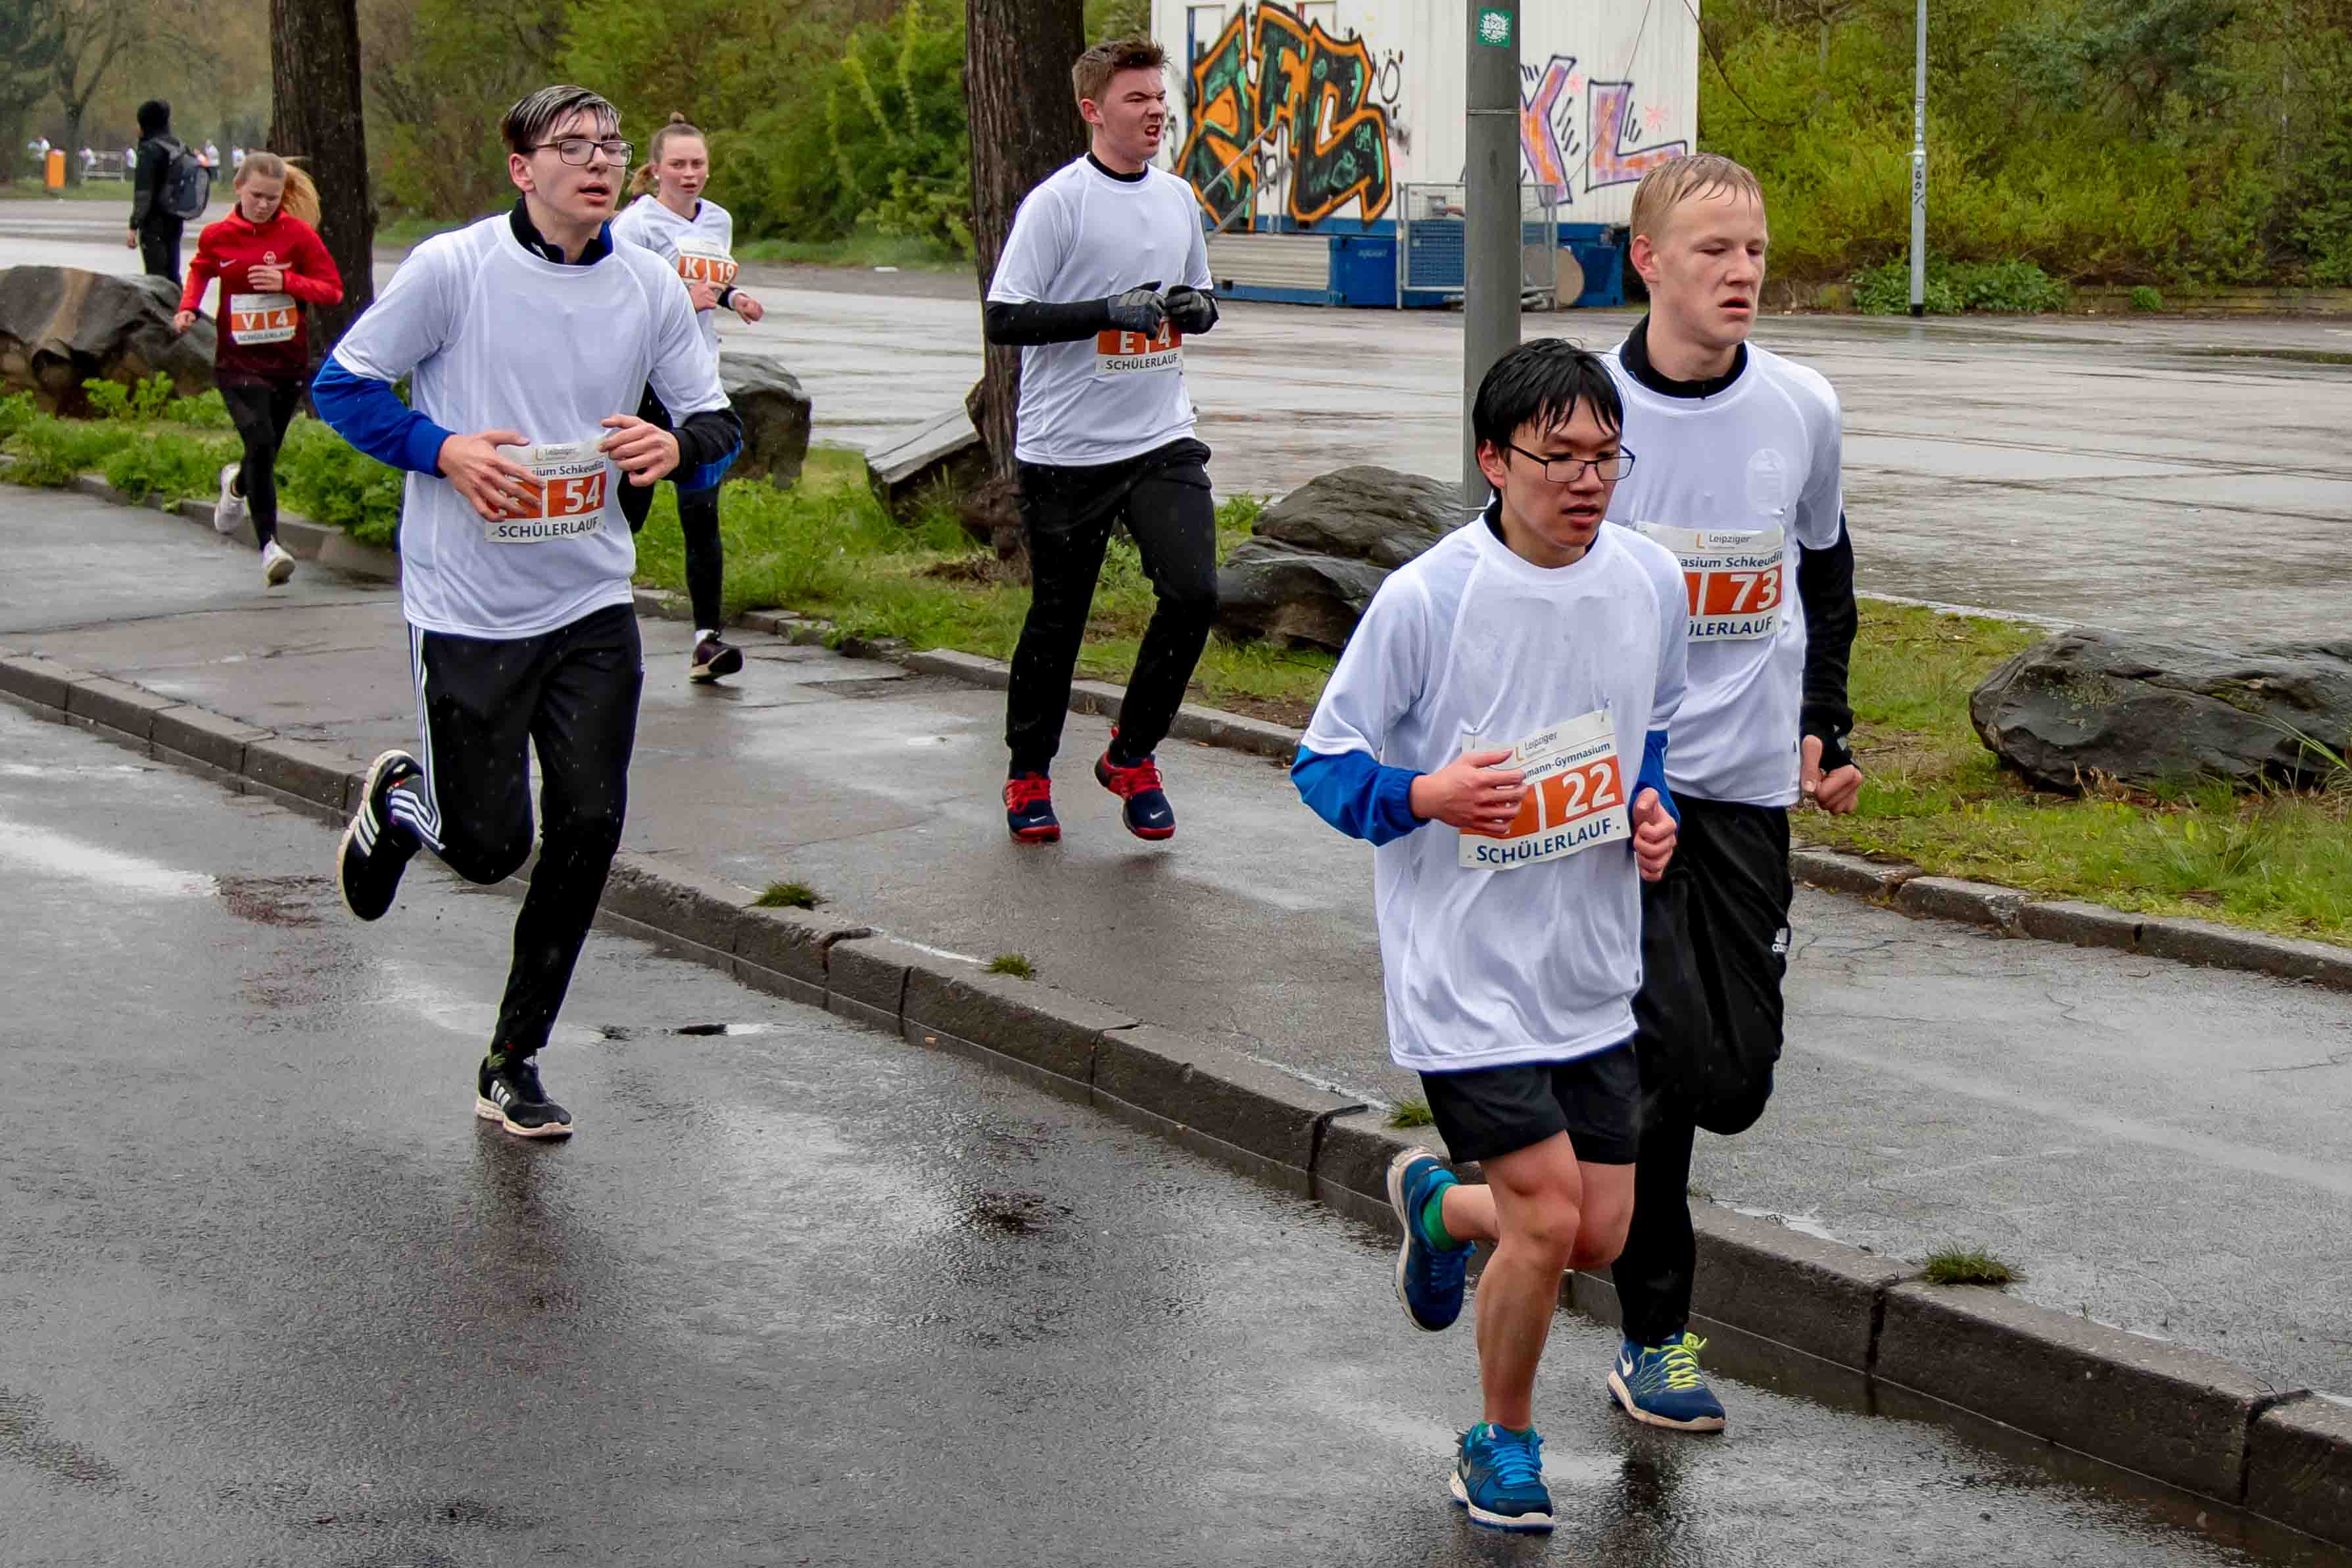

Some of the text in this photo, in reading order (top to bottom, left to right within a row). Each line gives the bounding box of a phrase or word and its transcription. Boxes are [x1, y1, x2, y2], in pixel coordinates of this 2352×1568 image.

[684, 257, 735, 284] K 19
[242, 310, 289, 330] V 4
[1120, 322, 1171, 353] E 4
[1105, 352, 1178, 370] SCHÜLERLAUF
[565, 475, 600, 513] 54
[498, 516, 598, 538] SCHÜLERLAUF
[1709, 534, 1752, 544] Leipziger
[1678, 556, 1721, 567] asium
[1730, 569, 1779, 611] 73
[1524, 730, 1558, 751] Leipziger
[1562, 761, 1616, 819] 22
[1476, 817, 1612, 864] SCHÜLERLAUF
